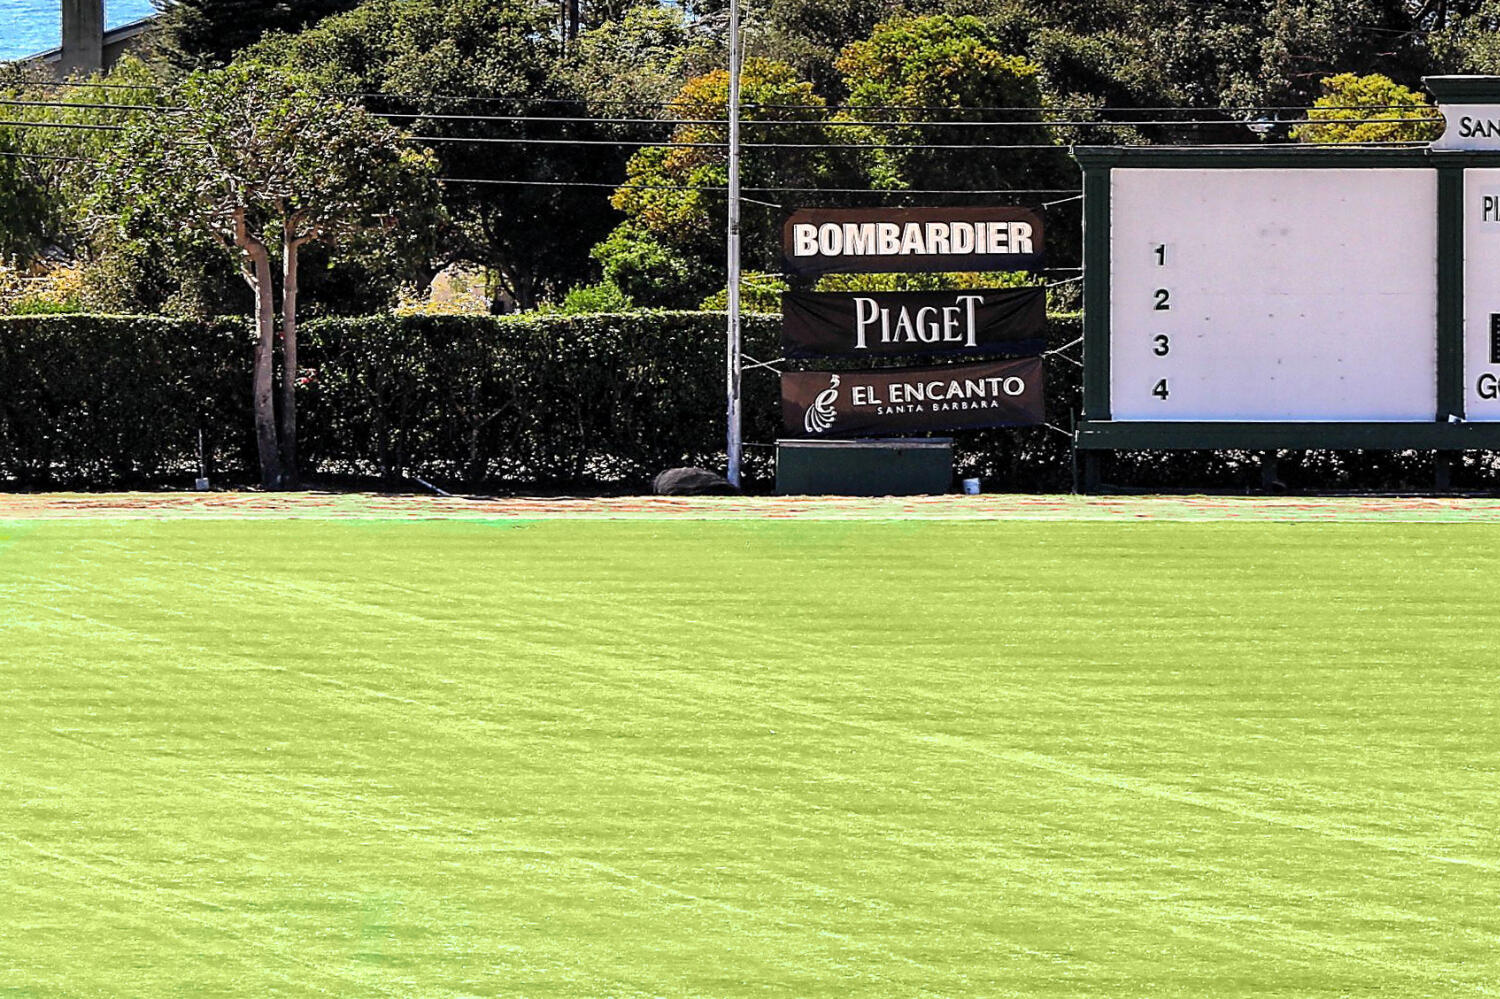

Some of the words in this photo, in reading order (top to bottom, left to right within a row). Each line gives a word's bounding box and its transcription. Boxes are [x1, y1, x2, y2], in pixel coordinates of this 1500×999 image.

[793, 221, 1034, 257] BOMBARDIER
[1154, 244, 1167, 266] 1
[1154, 288, 1170, 310] 2
[852, 295, 984, 349] PIAGET
[1154, 334, 1170, 357] 3
[852, 386, 882, 406] EL
[888, 376, 1025, 402] ENCANTO
[1152, 378, 1169, 401] 4
[876, 402, 924, 415] SANTA
[932, 399, 999, 412] BARBARA
